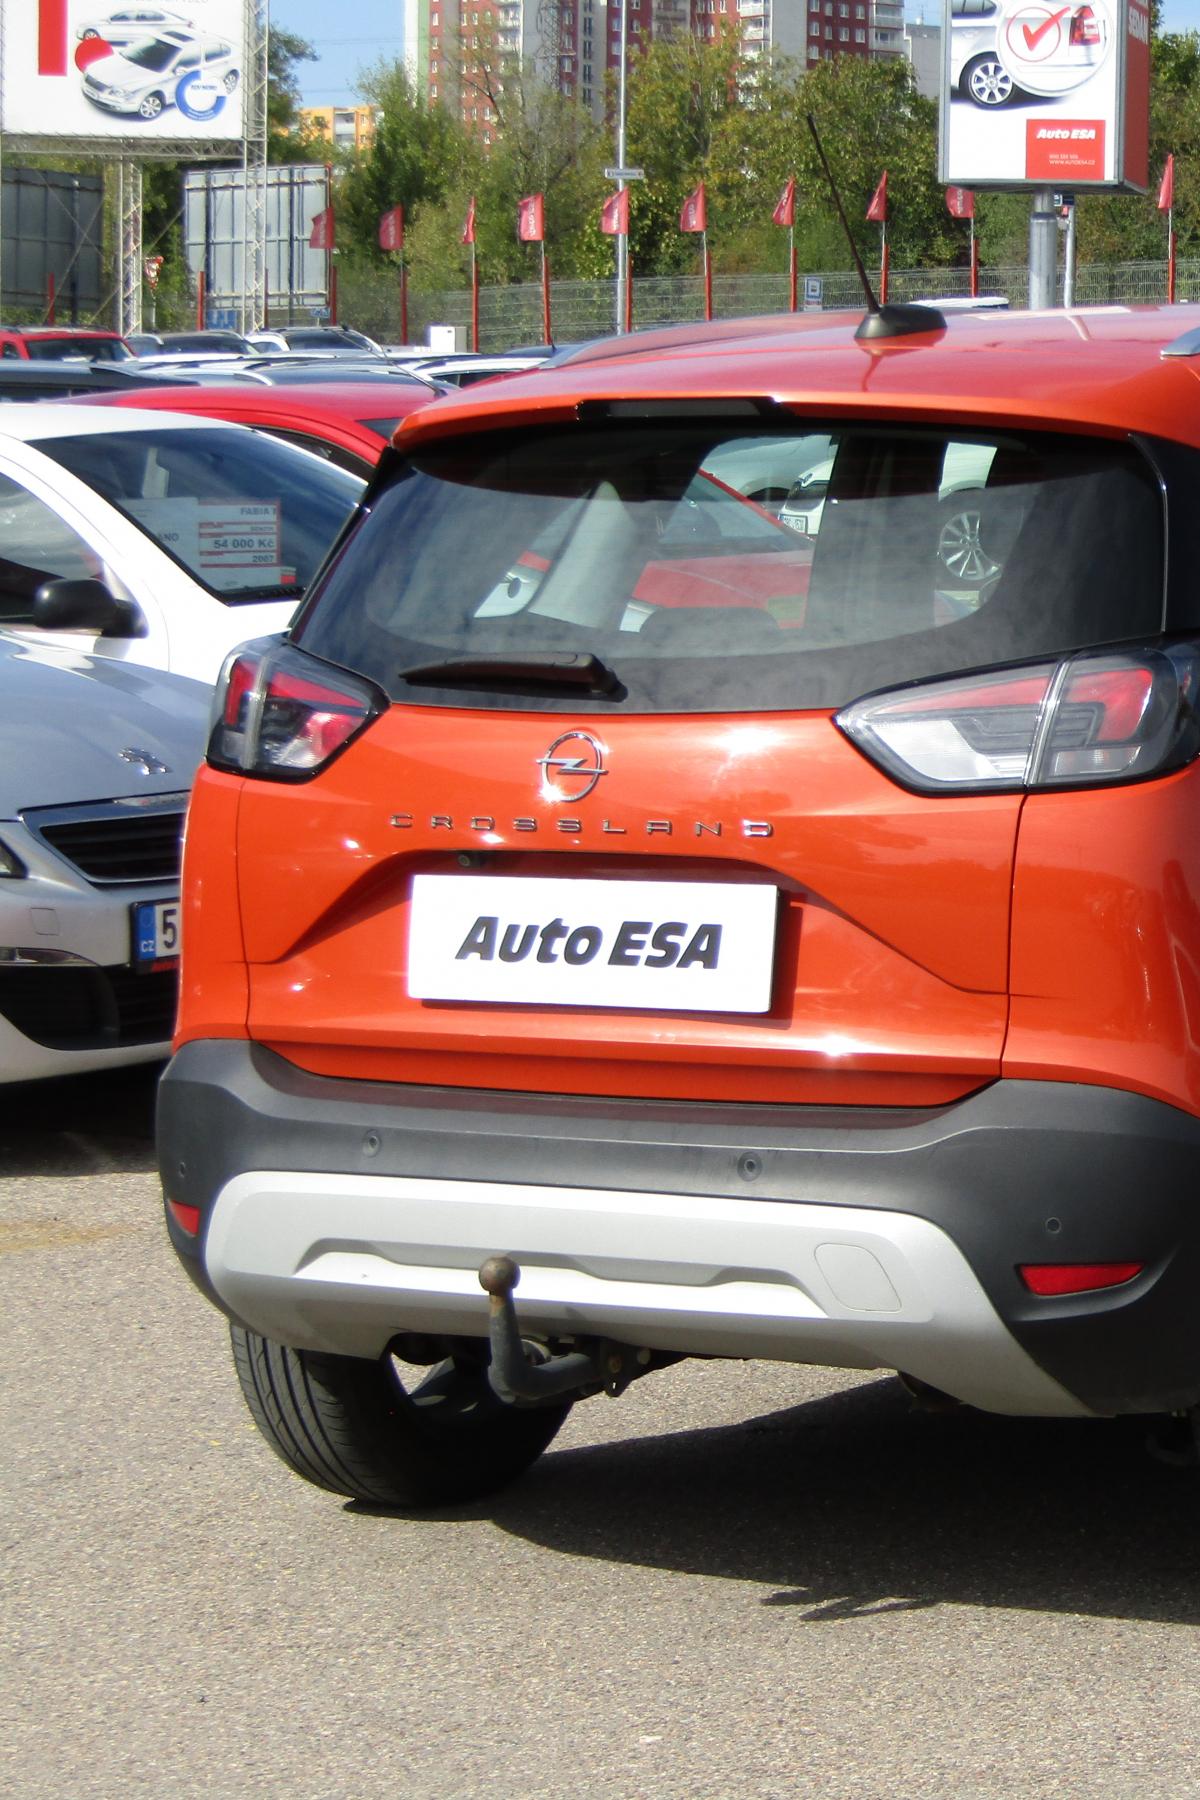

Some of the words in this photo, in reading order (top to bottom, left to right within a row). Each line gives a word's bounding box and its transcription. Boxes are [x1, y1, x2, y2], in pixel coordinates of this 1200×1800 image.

[1036, 128, 1070, 139] Auto
[1071, 129, 1096, 139] ESA
[214, 539, 229, 549] 54
[232, 539, 255, 548] 000
[258, 537, 274, 548] Kč
[252, 555, 274, 563] 2007
[390, 813, 773, 838] CROSSLAND
[141, 940, 155, 953] CZ
[454, 915, 604, 966] Auto
[607, 920, 723, 970] ESA
